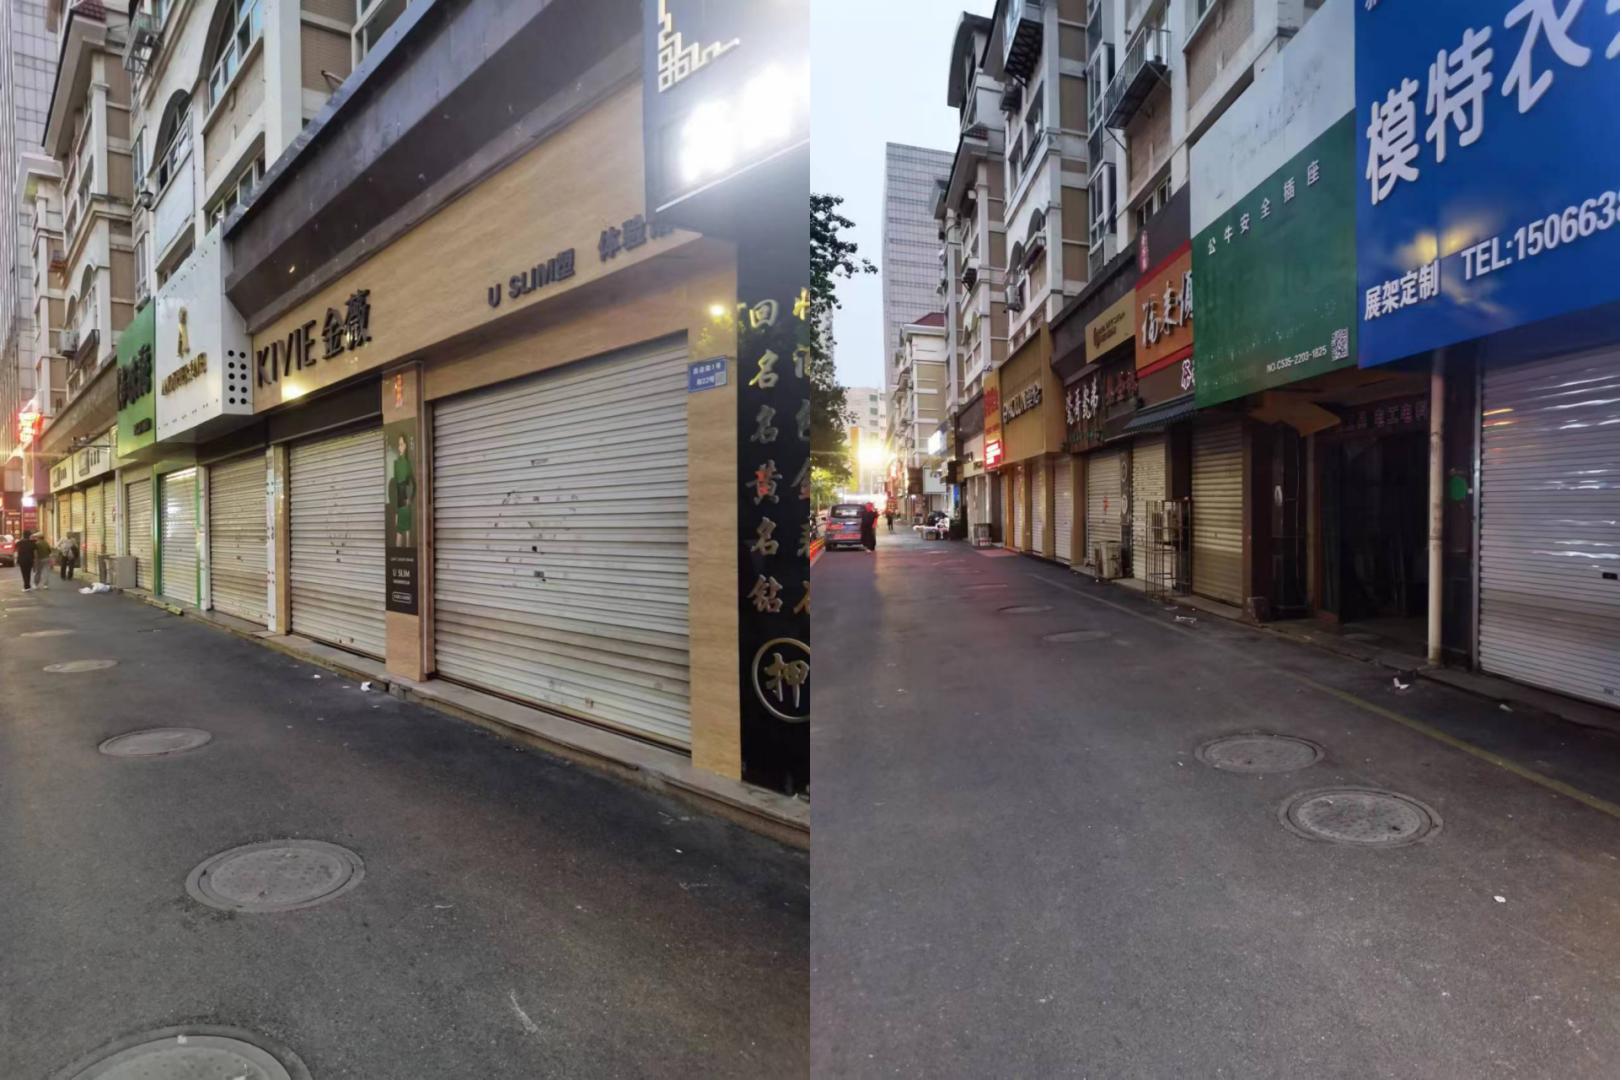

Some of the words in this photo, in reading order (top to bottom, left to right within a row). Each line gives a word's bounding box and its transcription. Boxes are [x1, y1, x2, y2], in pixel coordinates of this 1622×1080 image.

[1365, 0, 1620, 206] 模特衣
[1206, 157, 1321, 256] 公牛安全插座
[1460, 188, 1620, 282] TEL:150663
[1363, 257, 1442, 322] 展架定制
[763, 651, 811, 708] 押
